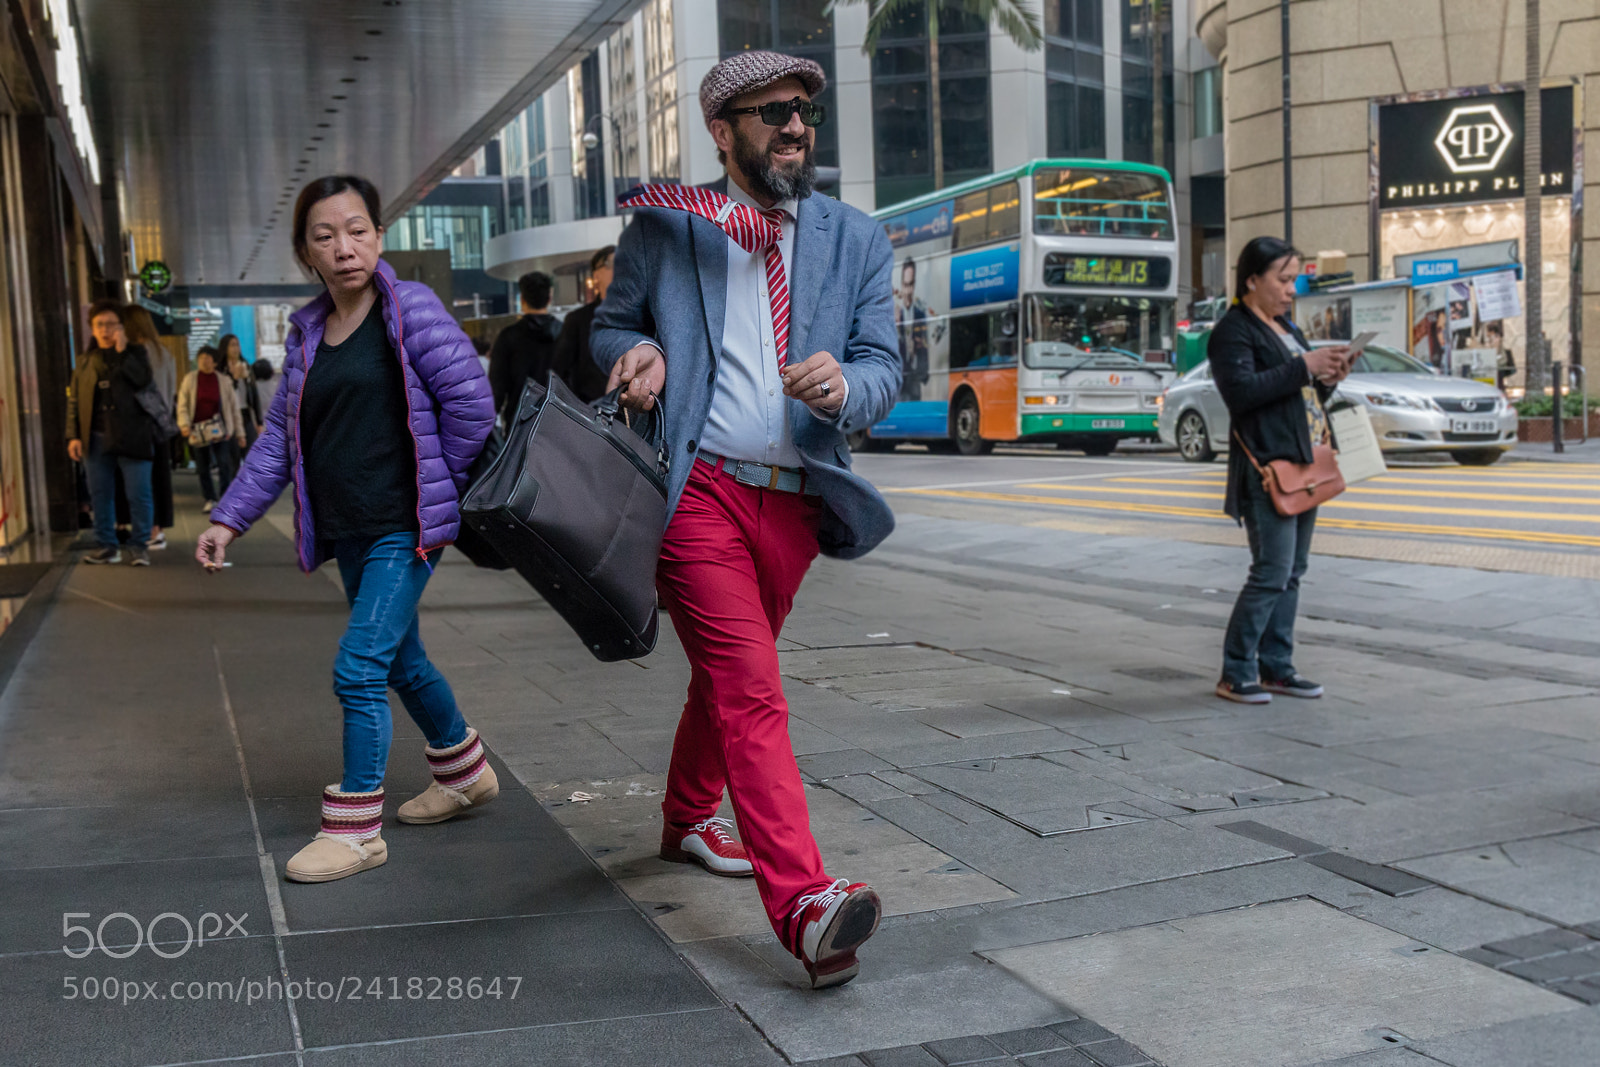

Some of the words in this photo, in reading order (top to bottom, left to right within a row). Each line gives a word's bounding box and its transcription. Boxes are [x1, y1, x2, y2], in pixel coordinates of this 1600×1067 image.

[1387, 180, 1480, 199] PHILIPP
[1494, 172, 1564, 191] PLIN
[1130, 260, 1148, 283] 13
